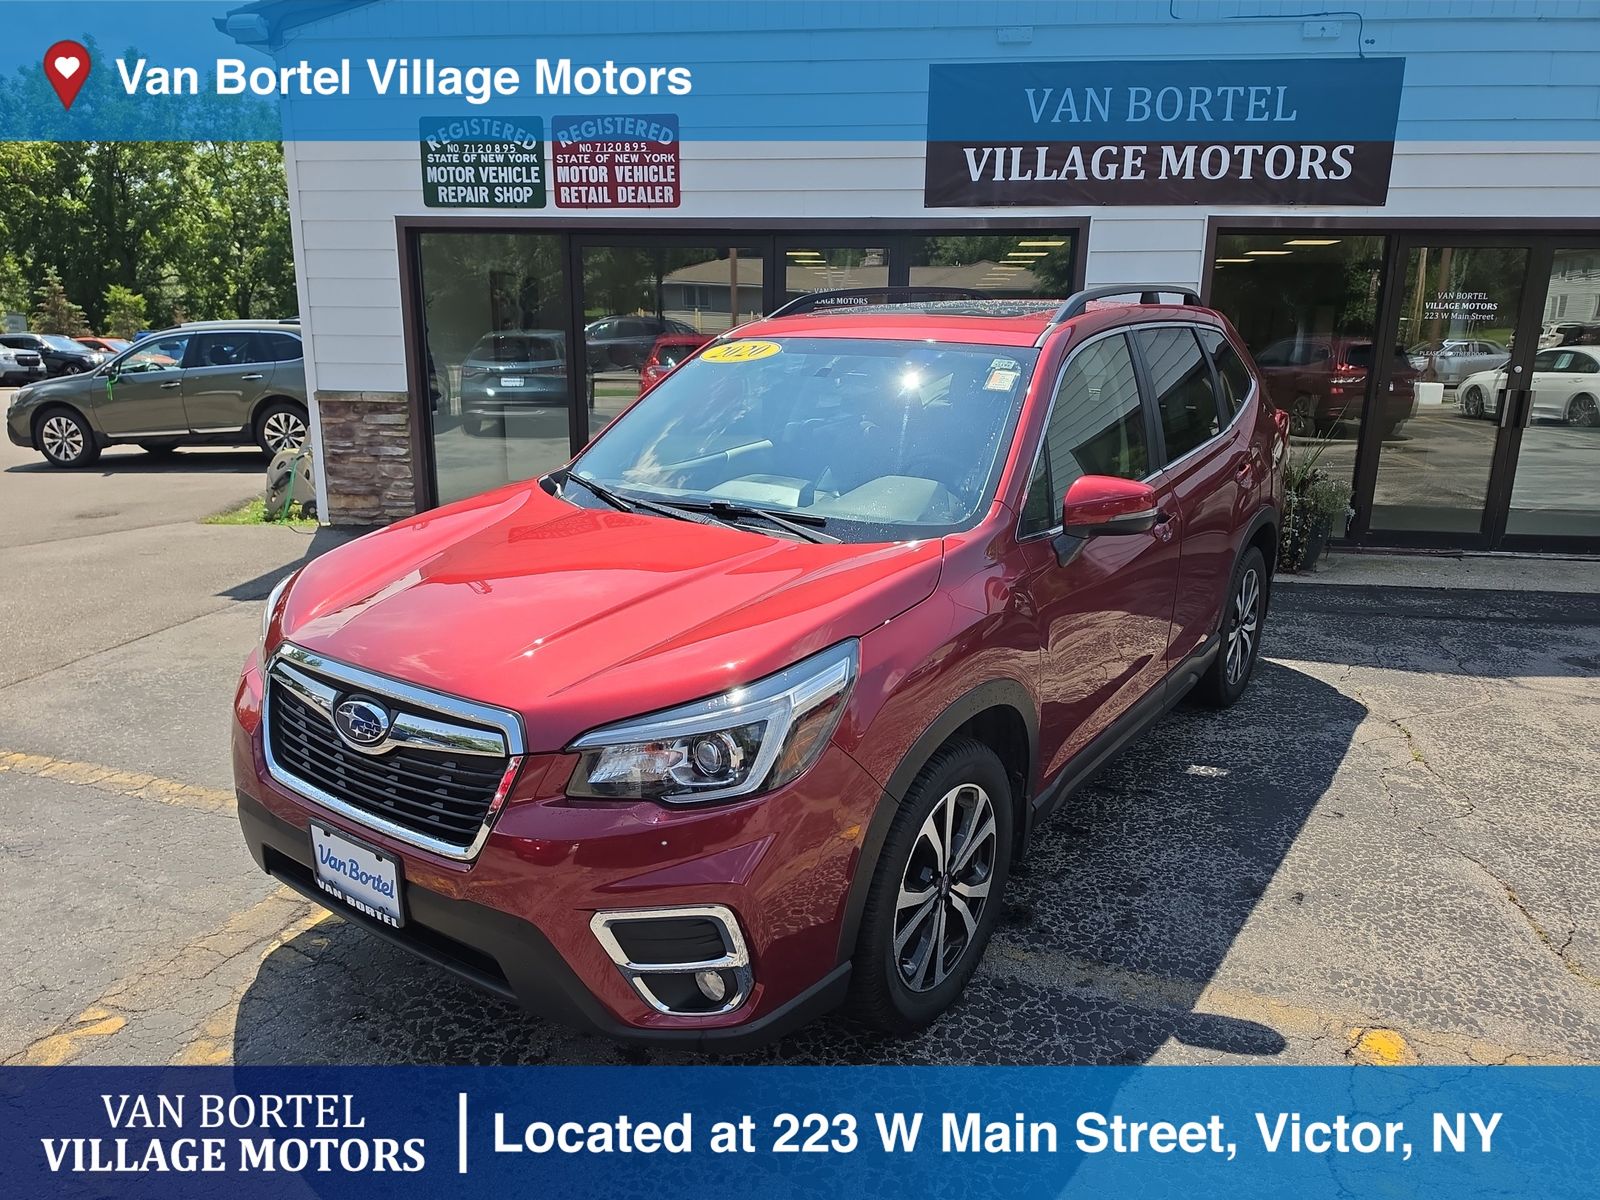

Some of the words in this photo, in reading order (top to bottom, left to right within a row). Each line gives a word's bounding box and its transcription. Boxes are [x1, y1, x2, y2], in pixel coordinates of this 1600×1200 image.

[1025, 87, 1113, 123] VAN
[1126, 86, 1298, 122] BORTEL
[425, 118, 537, 151] REGISTERED
[556, 116, 674, 148] REGISTERED
[463, 144, 516, 153] 7120895
[595, 142, 647, 152] 7120895
[427, 153, 460, 163] STATE
[463, 154, 478, 163] OF
[480, 154, 504, 163] NEW
[508, 154, 538, 163] YORK
[556, 154, 591, 163] STATE
[595, 154, 610, 163] OF
[615, 154, 639, 163] NEW
[643, 153, 676, 163] YORK
[963, 146, 1147, 181] VILLAGE
[1158, 144, 1355, 180] MOTORS
[426, 166, 475, 183] MOTOR
[479, 166, 541, 183] VEHICLE
[556, 165, 608, 183] MOTOR
[614, 165, 676, 183] VEHICLE
[437, 186, 489, 203] REPAIR
[494, 186, 533, 203] SHOP
[560, 186, 612, 204] RETAIL
[617, 186, 674, 204] DEALER
[836, 297, 869, 305] MOTORS
[1437, 292, 1455, 300] VAN
[1456, 292, 1488, 300] BORTEL
[1425, 302, 1460, 310] VILLAGE
[1461, 302, 1498, 310] MOTORS
[1424, 312, 1439, 320] 223
[1450, 312, 1469, 320] Main
[1470, 312, 1495, 320] Street
[316, 878, 343, 900] VAN
[346, 894, 400, 929] BORTEL
